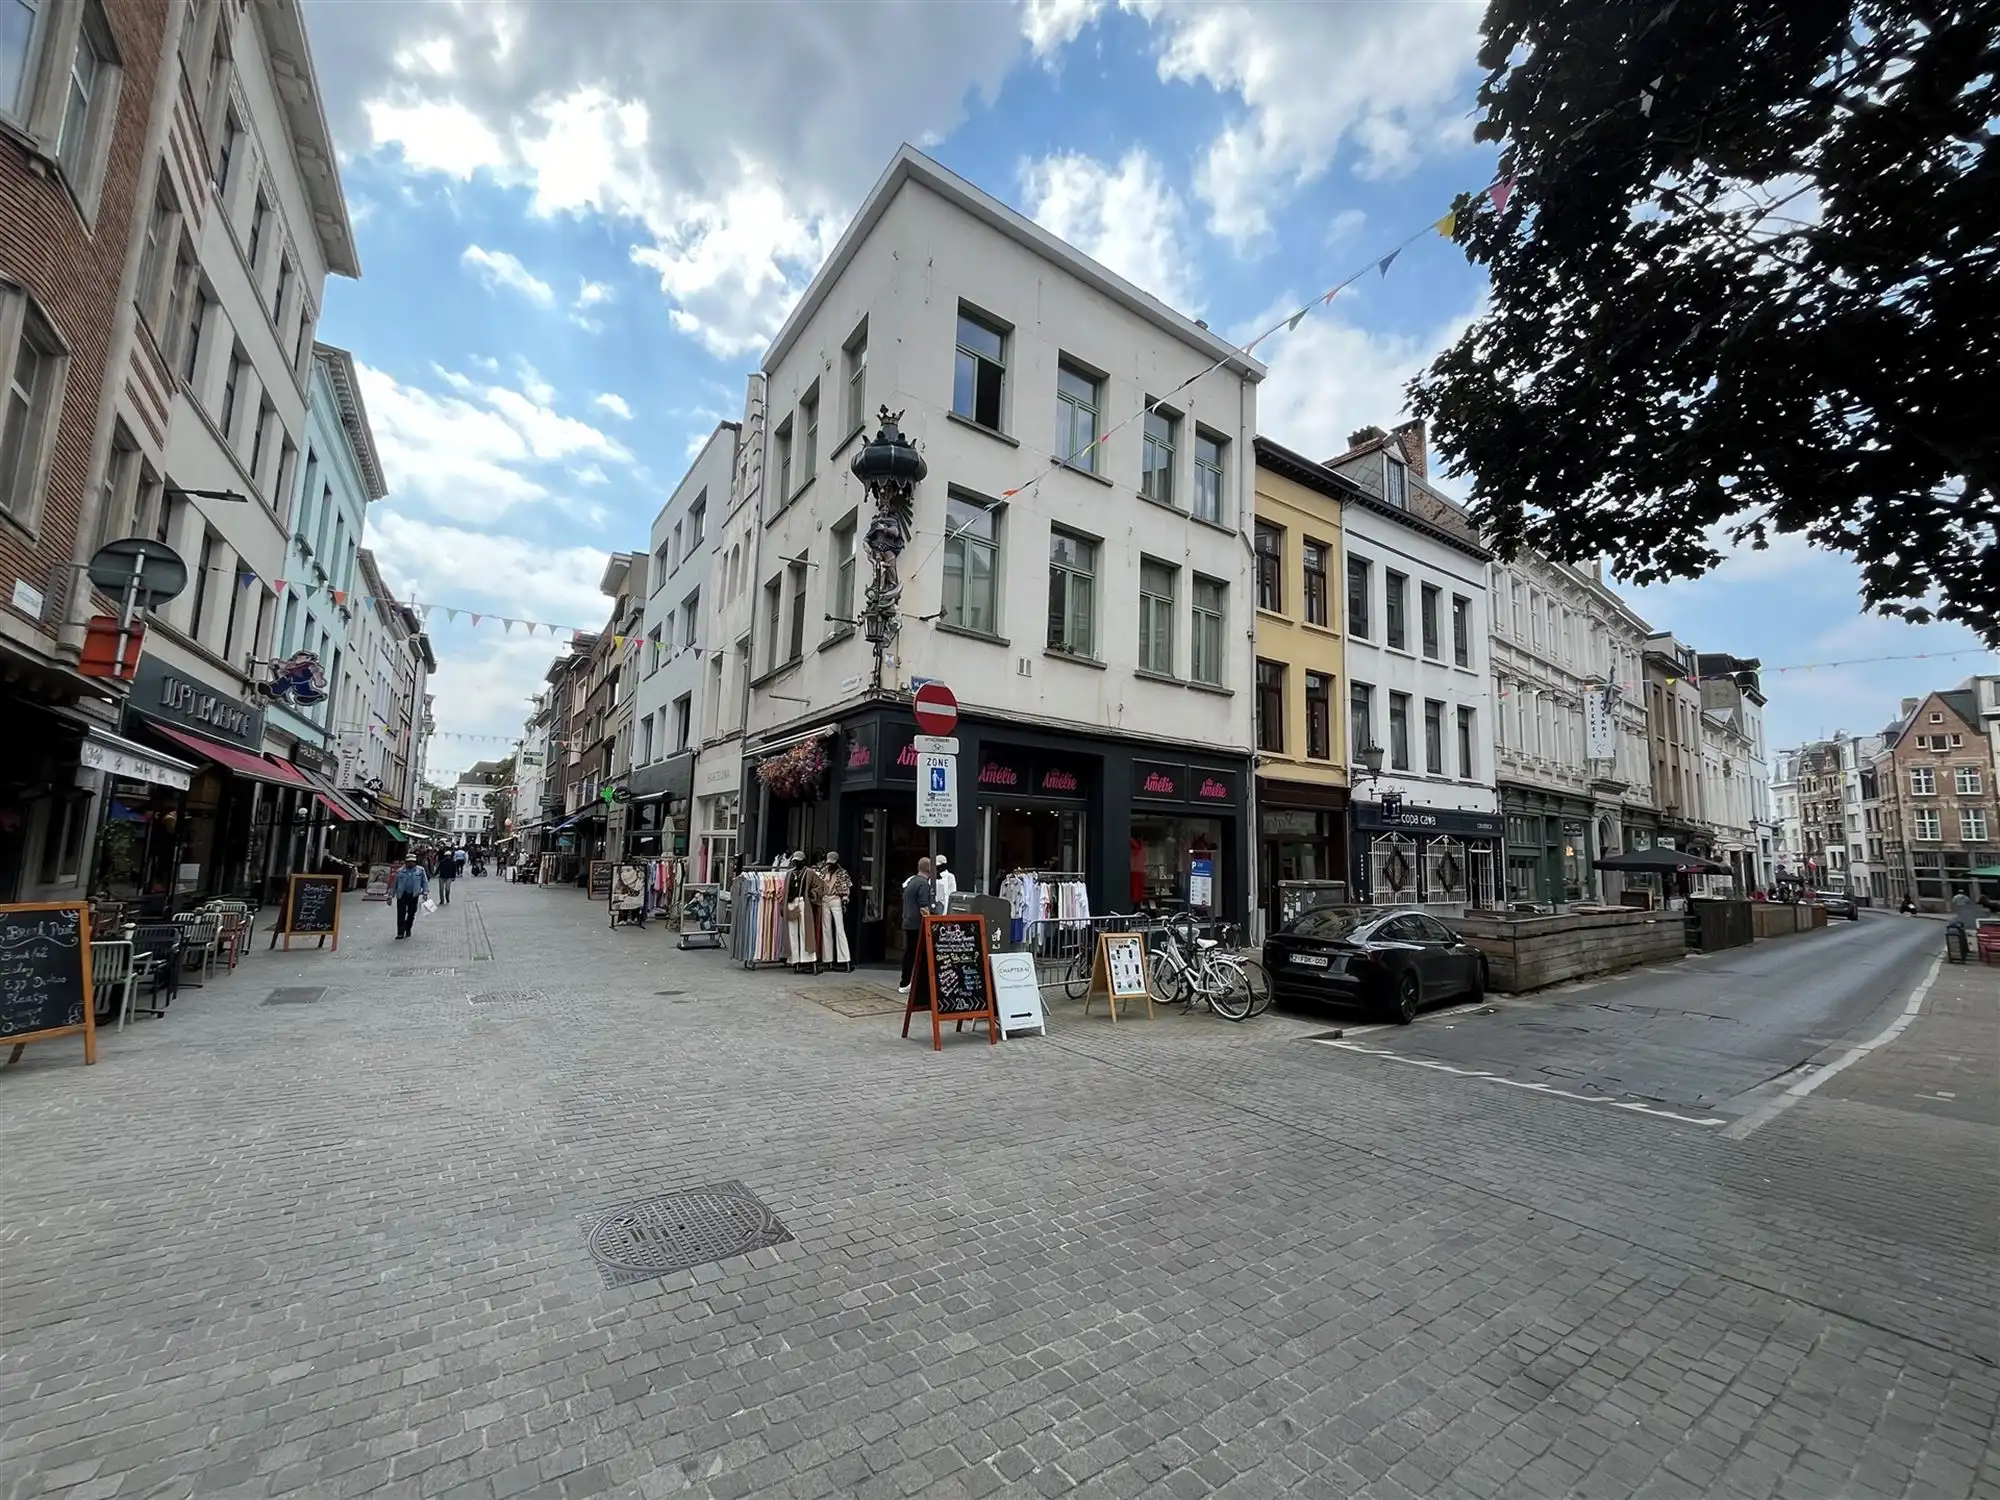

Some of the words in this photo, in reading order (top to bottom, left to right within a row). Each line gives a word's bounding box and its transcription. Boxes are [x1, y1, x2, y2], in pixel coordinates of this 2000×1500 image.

[926, 757, 949, 767] ZONE
[978, 766, 1017, 785] Amélie
[1042, 772, 1077, 790] Amélie
[1143, 774, 1174, 793] Amélie
[1200, 780, 1227, 798] Amélie
